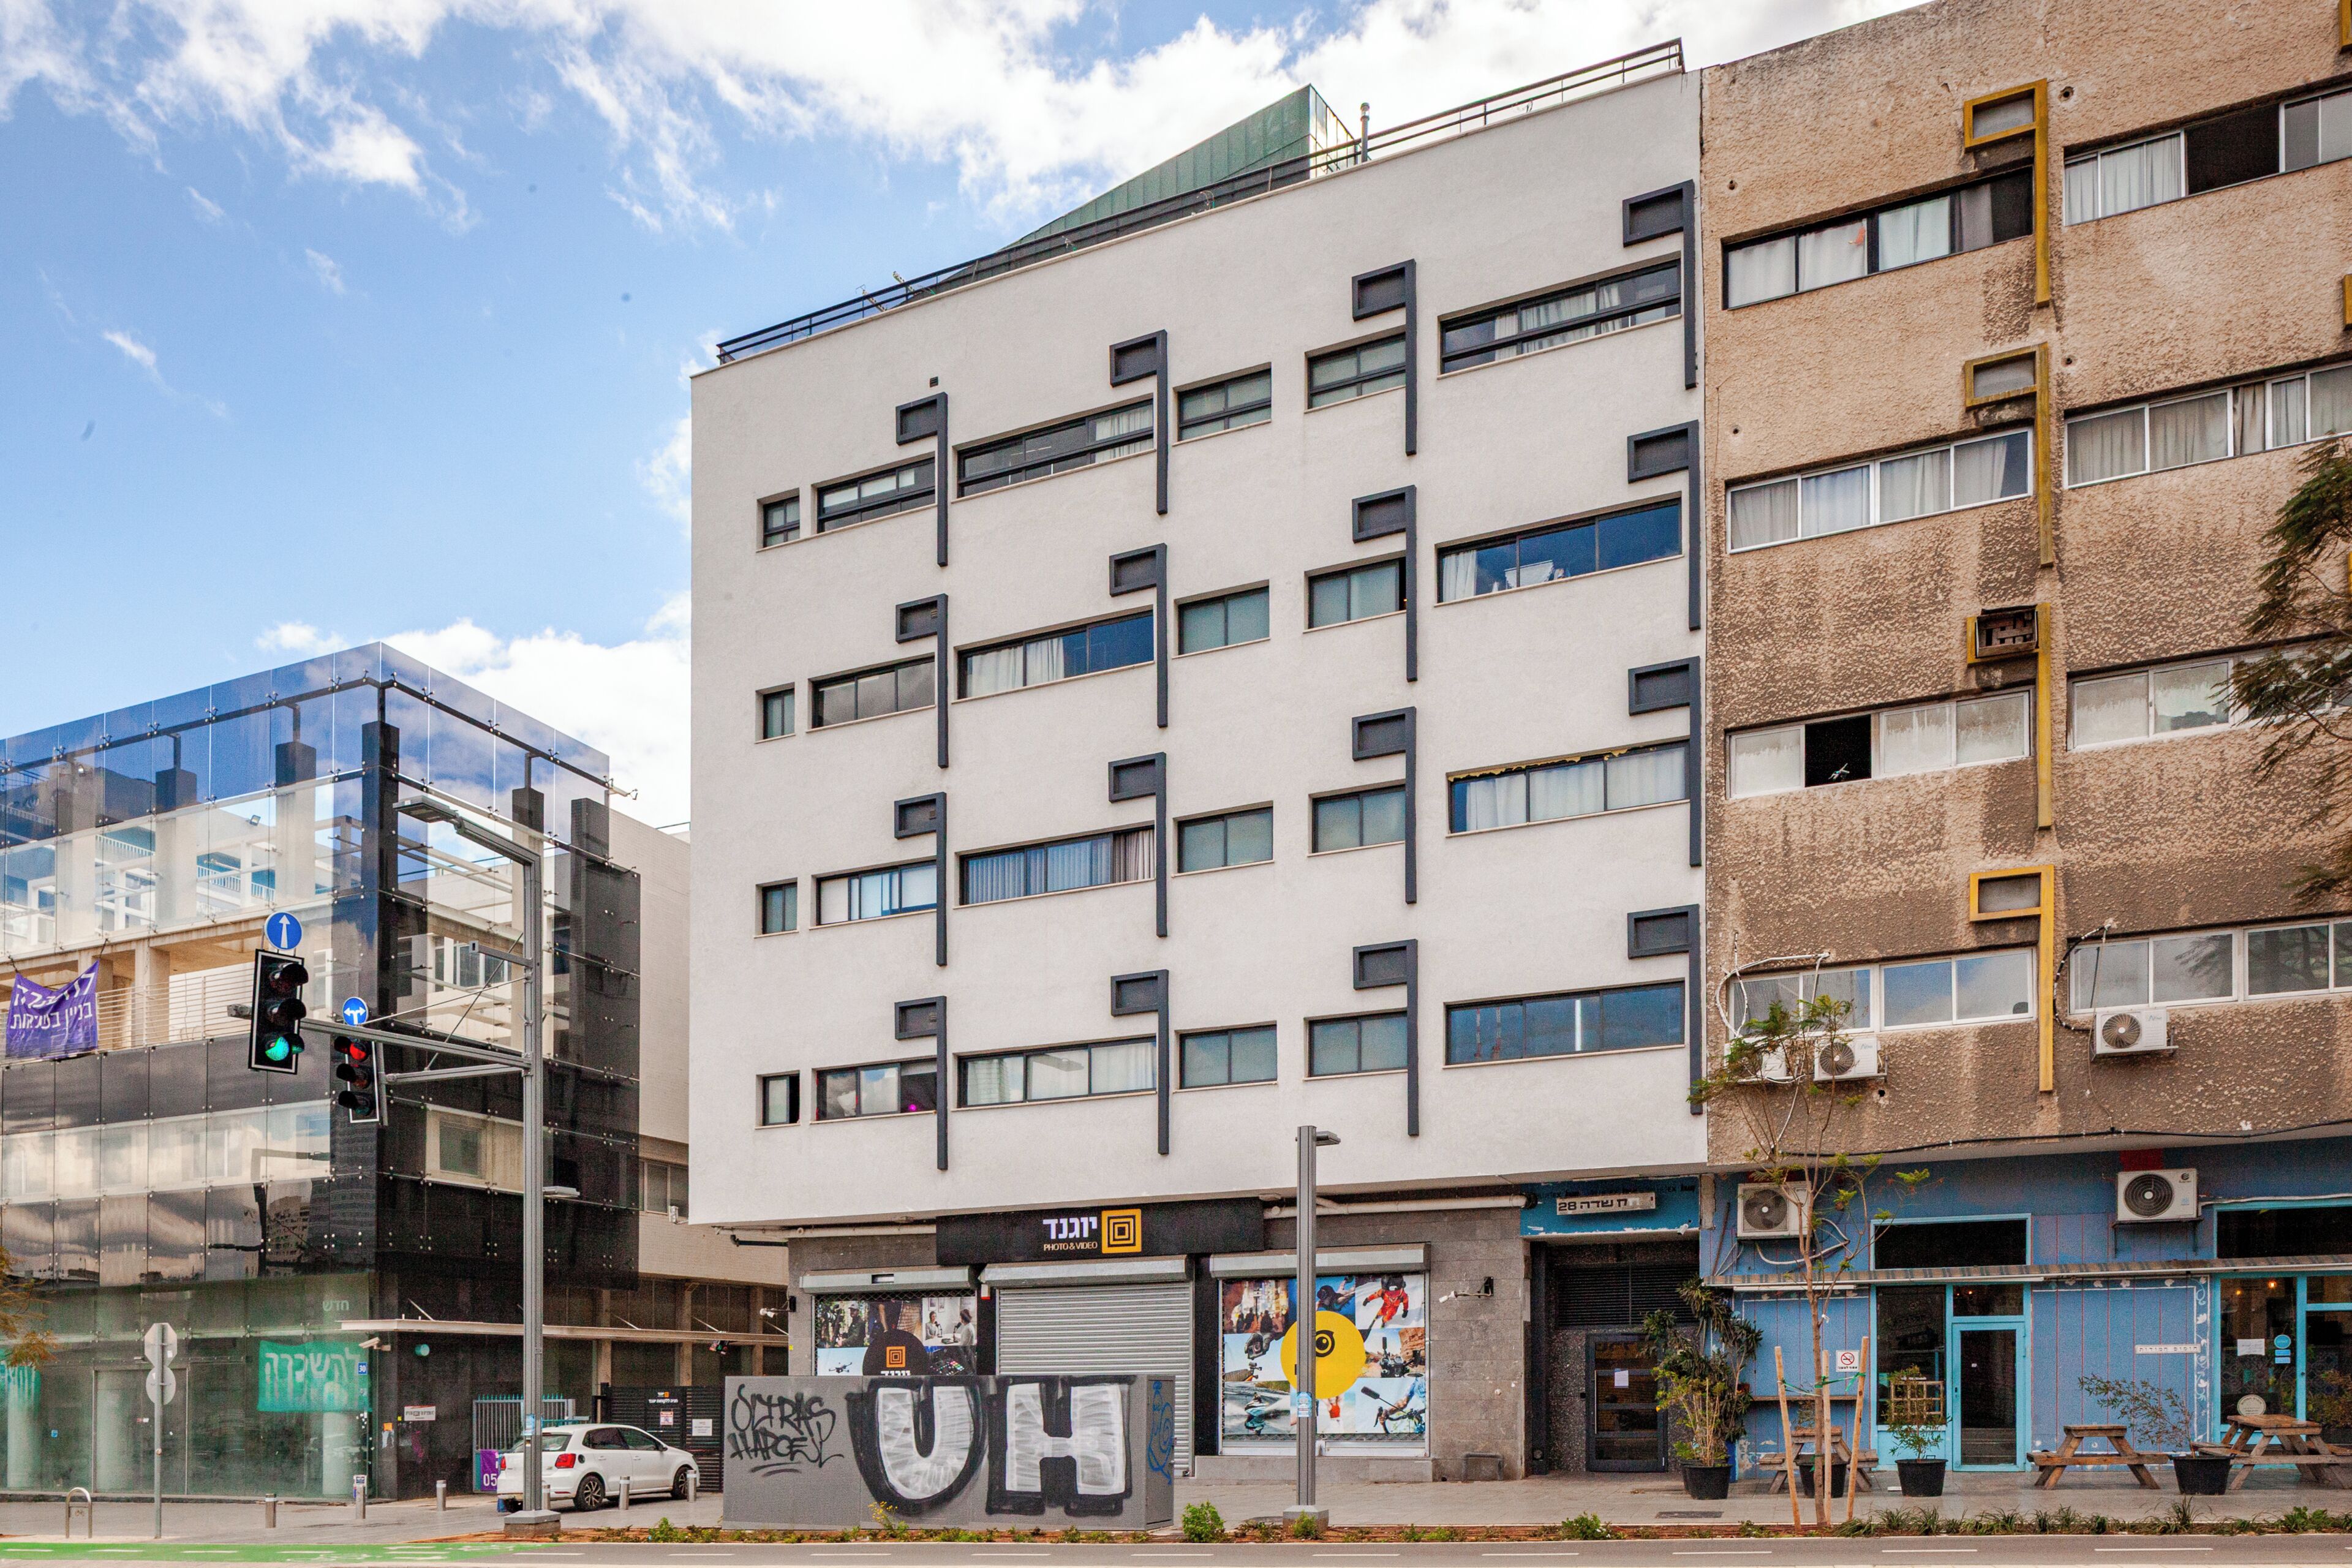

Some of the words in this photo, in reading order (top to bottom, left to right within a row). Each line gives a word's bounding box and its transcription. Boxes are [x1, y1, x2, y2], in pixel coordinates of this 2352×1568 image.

[66, 1001, 92, 1036] בניין
[1558, 1201, 1577, 1211] 28
[1580, 1199, 1613, 1208] שדה
[1042, 1216, 1098, 1239] יוגנד
[323, 1300, 349, 1311] חדש
[265, 1348, 361, 1404] להשכרה
